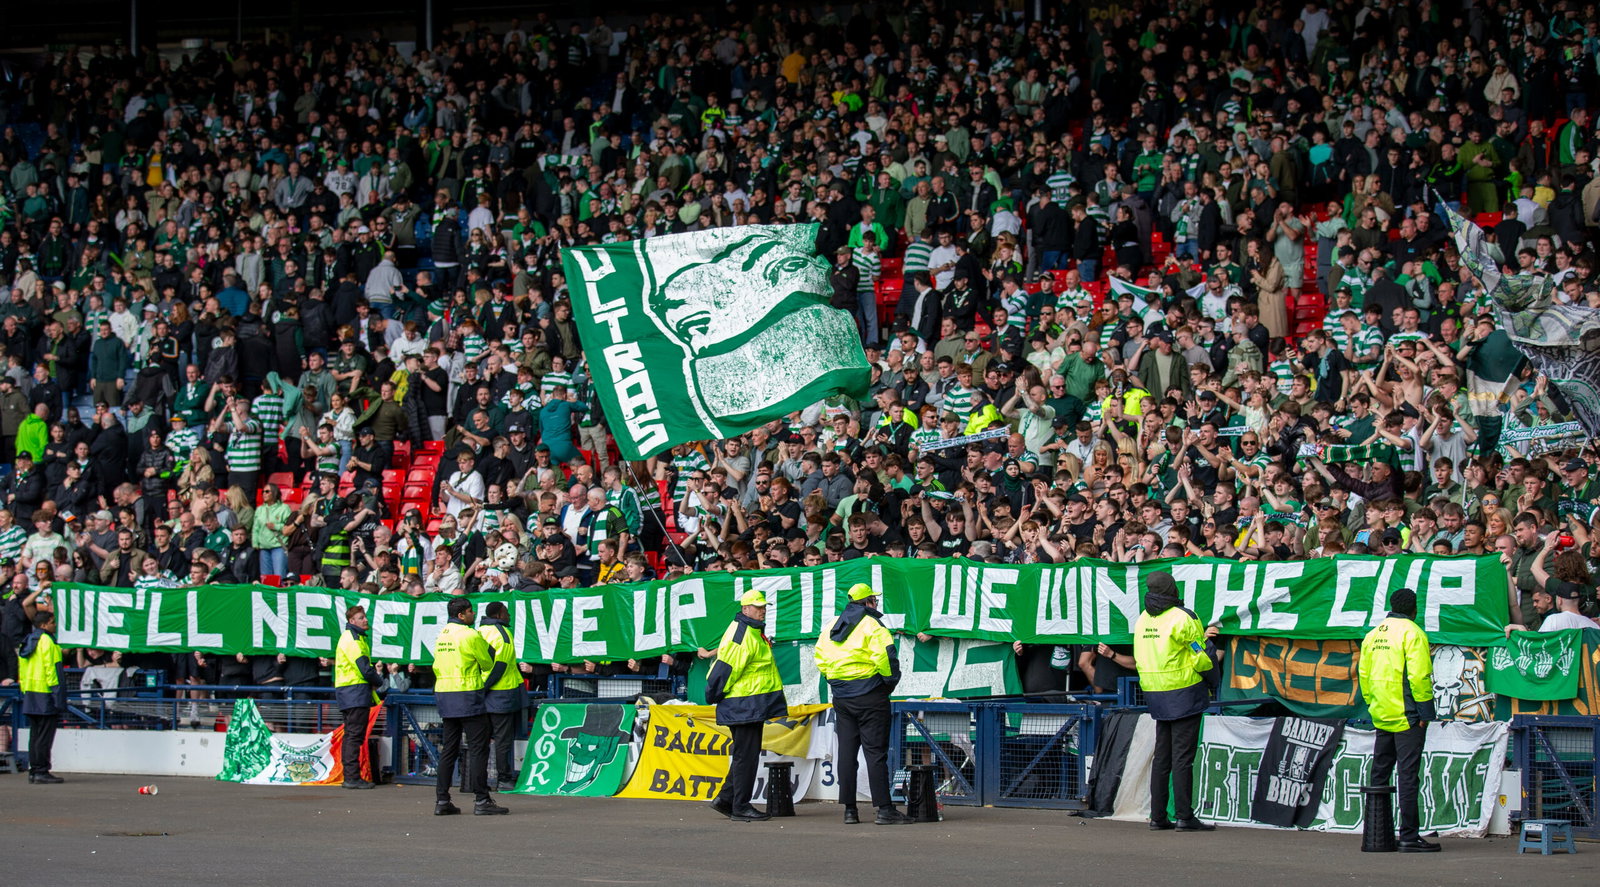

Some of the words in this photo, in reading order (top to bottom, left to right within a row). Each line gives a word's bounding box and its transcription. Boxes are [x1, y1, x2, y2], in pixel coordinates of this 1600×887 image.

[571, 248, 669, 456] ULTRAS
[57, 588, 223, 648] WE'LL
[475, 595, 607, 660] IVE
[633, 578, 707, 652] UP
[930, 564, 1019, 633] WE
[1036, 565, 1140, 635] WIN
[1171, 561, 1305, 630] THE
[1326, 558, 1477, 632] CUP
[525, 706, 561, 792] OGR
